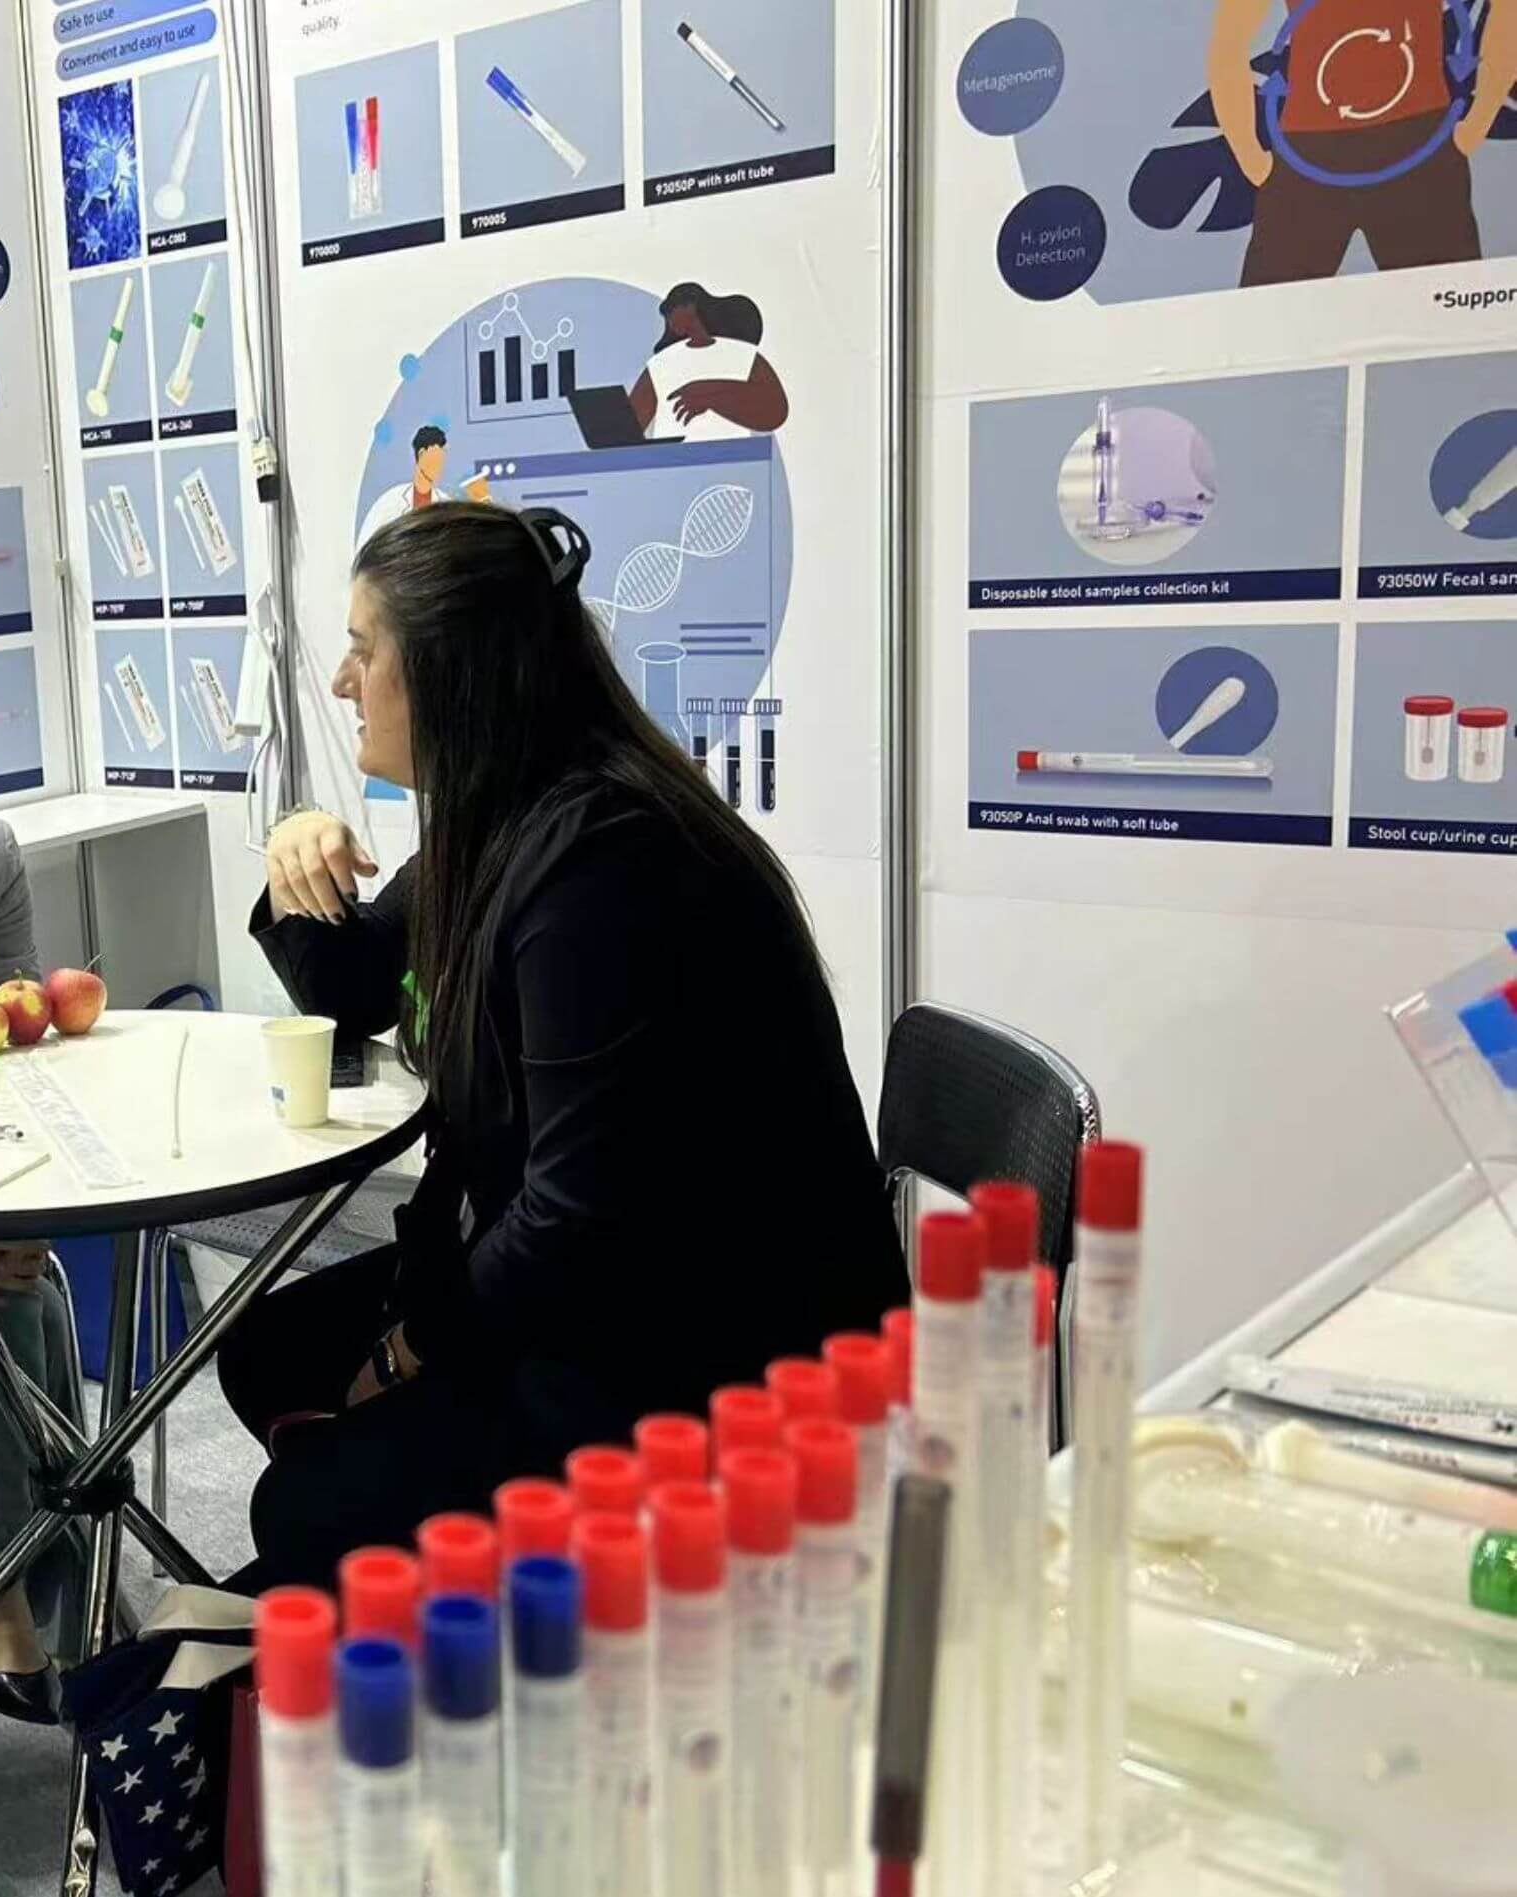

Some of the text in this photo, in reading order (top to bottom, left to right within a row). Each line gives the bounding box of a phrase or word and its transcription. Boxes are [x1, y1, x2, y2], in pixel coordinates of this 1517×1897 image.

[60, 7, 115, 33] Safe to use
[61, 24, 196, 72] Convenient and easy to use
[963, 64, 1057, 94] Metagenome
[654, 165, 774, 196] 93050P with soft tube
[1015, 246, 1086, 267] Detection
[981, 580, 1230, 603] Disposable stool samples collection kit
[1377, 572, 1438, 589] 93050W
[1443, 571, 1484, 586] Fecal
[979, 810, 1179, 832] 93050P Anal swab with soft tube
[1368, 825, 1517, 848] Stool cup/urine cup
